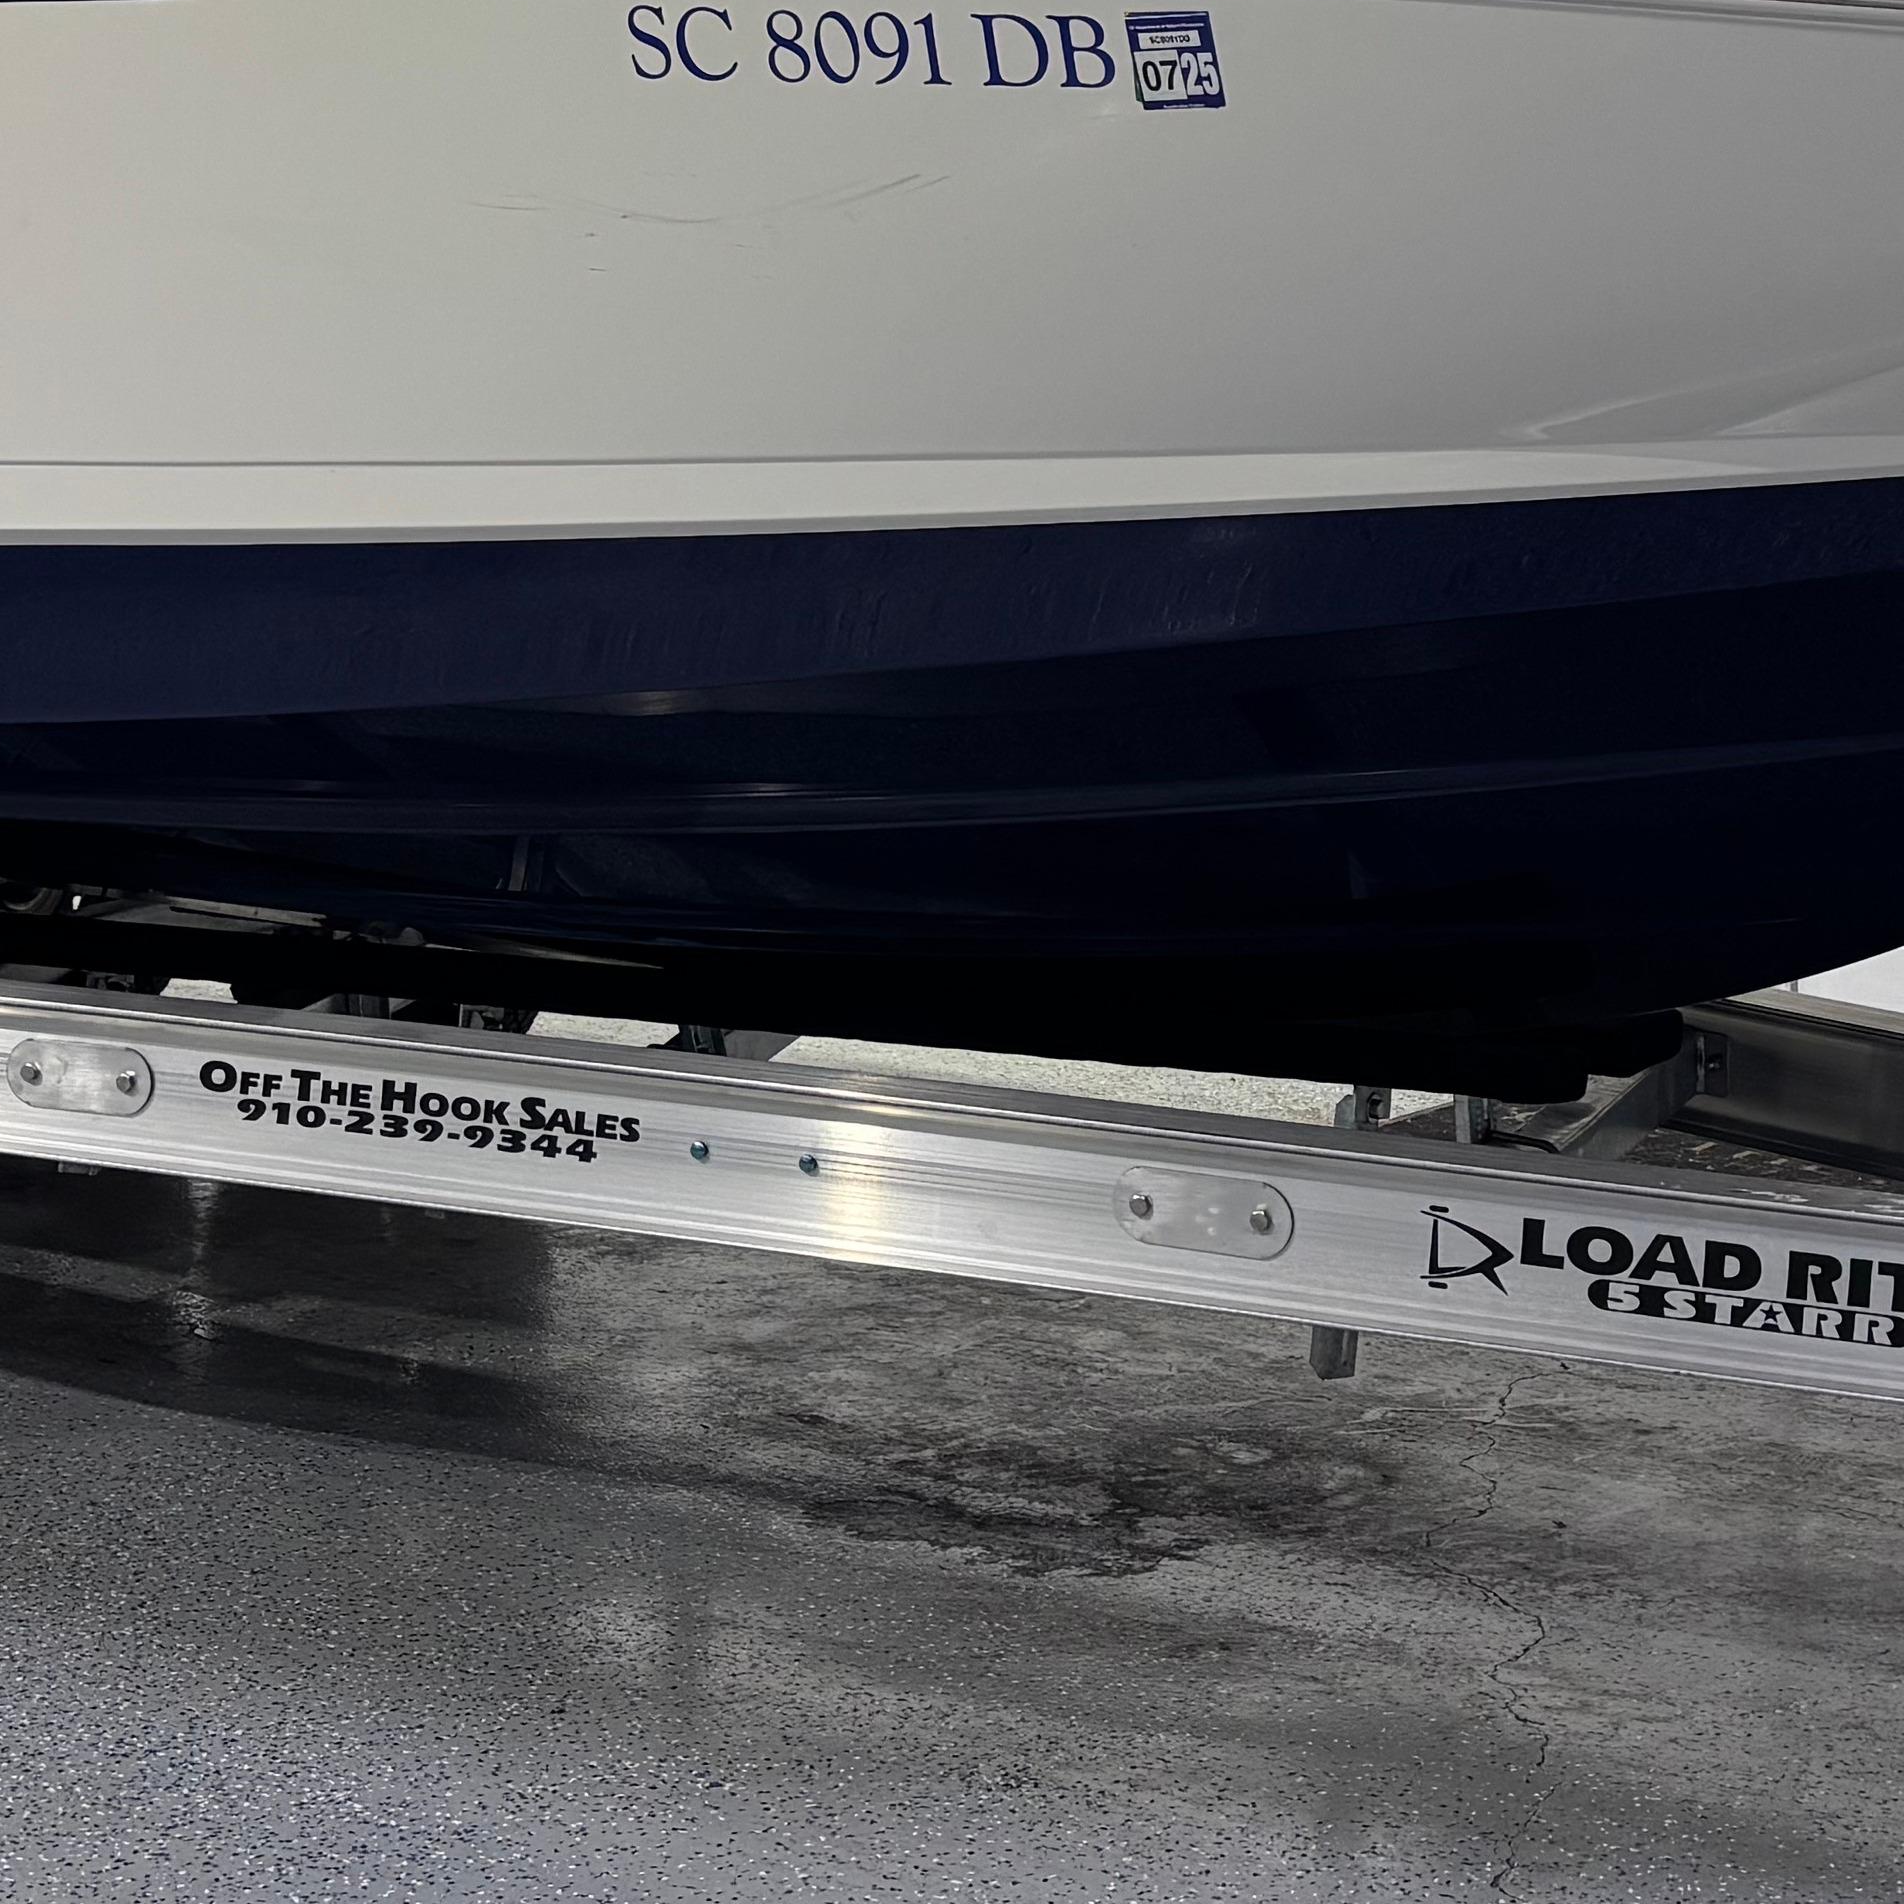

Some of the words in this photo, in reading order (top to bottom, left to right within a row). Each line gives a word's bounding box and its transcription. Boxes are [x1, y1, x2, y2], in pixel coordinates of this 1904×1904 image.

[627, 4, 739, 83] SC
[766, 9, 953, 87] 8091
[970, 11, 1117, 89] DB
[1141, 59, 1178, 92] 07
[1179, 52, 1221, 97] 25
[199, 1060, 283, 1097] OFF
[290, 1069, 373, 1110] THE
[380, 1079, 511, 1126] HOOK
[520, 1097, 641, 1143] SALES
[237, 1098, 598, 1164] 910-239-9344
[1520, 1216, 1762, 1293] LOAD
[1607, 1280, 1641, 1312] 5
[1663, 1292, 1895, 1346] STARR
